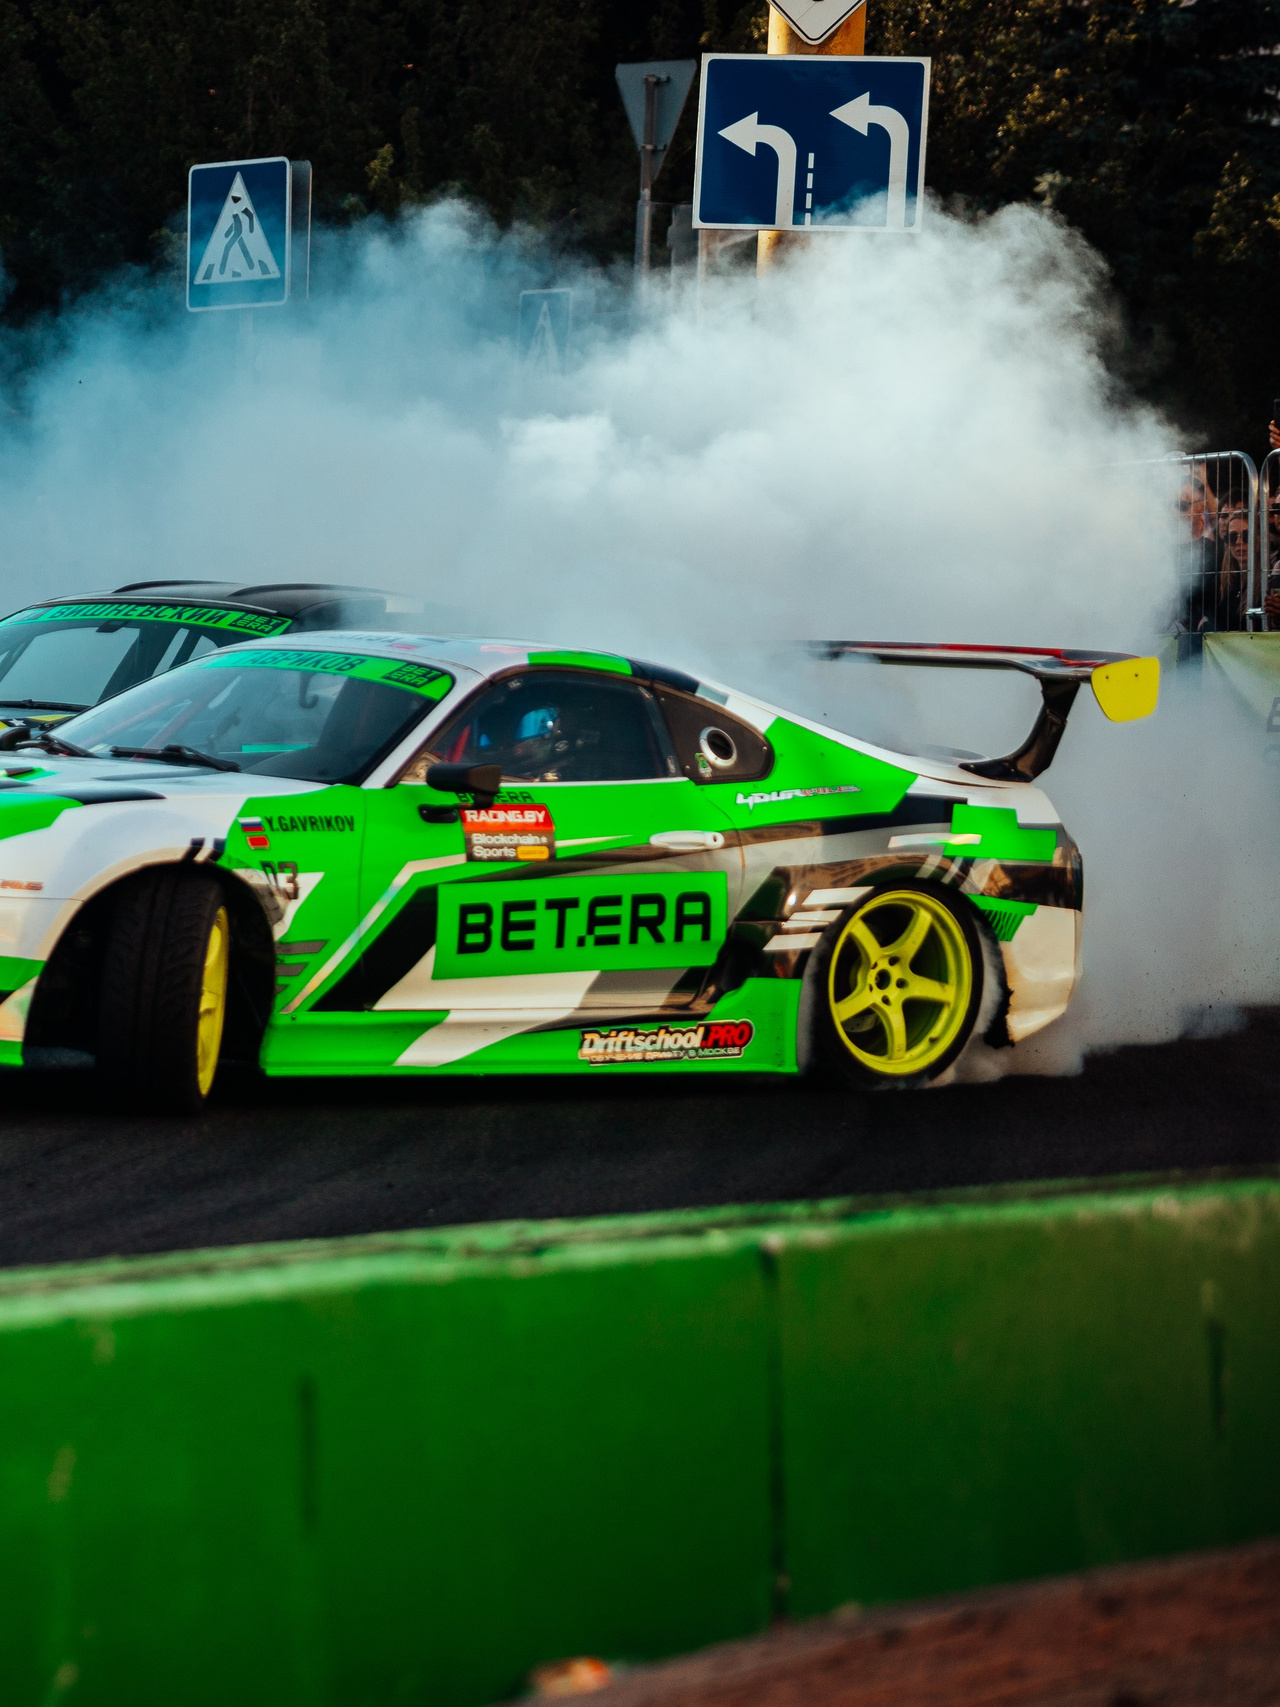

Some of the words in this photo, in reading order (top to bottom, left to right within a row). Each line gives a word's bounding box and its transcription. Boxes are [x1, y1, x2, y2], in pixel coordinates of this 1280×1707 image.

[49, 604, 232, 625] ВИШНЕВСКИЙ
[232, 651, 368, 672] ГАВРИКОВ
[401, 664, 442, 677] BET
[264, 815, 355, 832] Y.GAVRIKOV
[471, 833, 540, 845] Blockchain
[472, 845, 517, 858] Sports
[457, 891, 712, 954] BET.ERA
